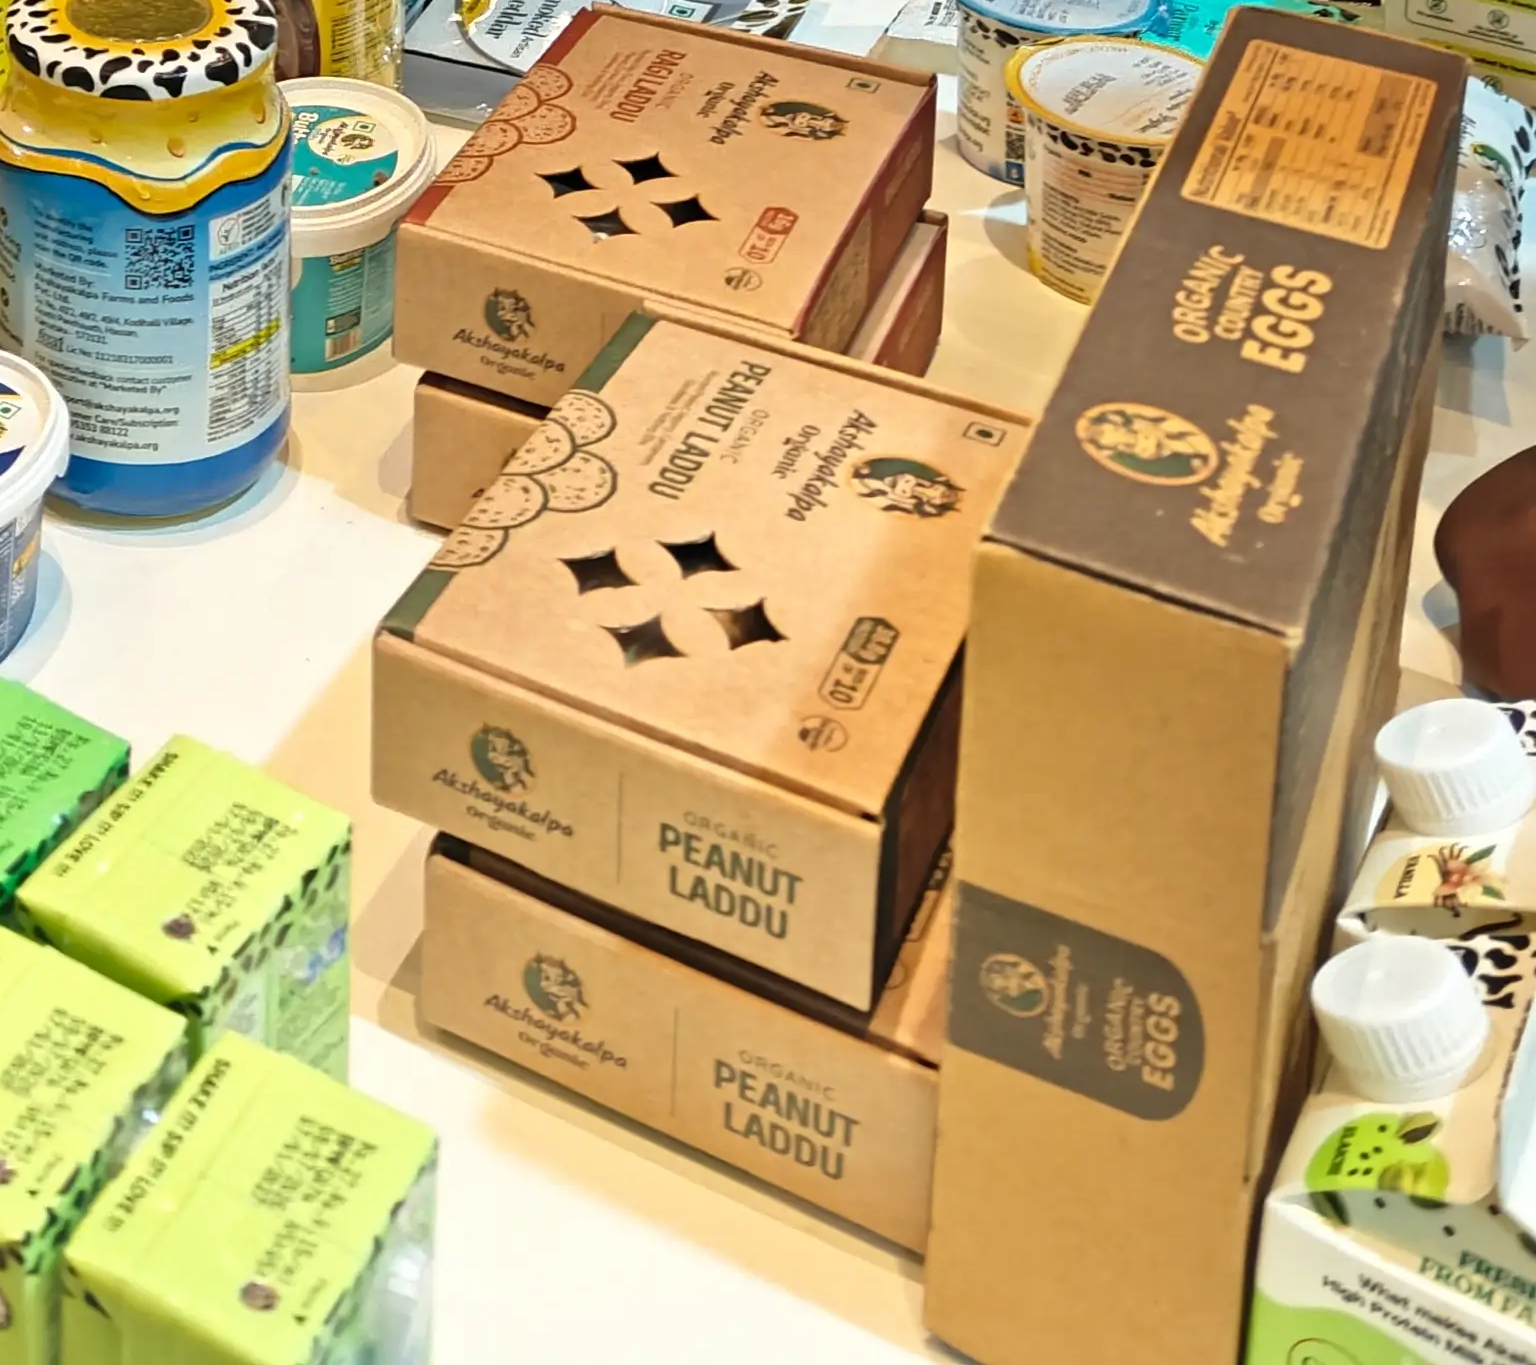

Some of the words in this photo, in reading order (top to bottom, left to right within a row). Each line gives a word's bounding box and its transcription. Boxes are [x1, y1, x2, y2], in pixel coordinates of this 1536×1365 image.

[610, 75, 662, 123] LADDU
[653, 50, 687, 89] RAGI
[709, 71, 779, 146] Akshayakalpa
[102, 292, 135, 304] Farms
[138, 295, 159, 304] and
[162, 293, 194, 303] Foods
[1172, 245, 1245, 343] ORGANIC
[1214, 265, 1263, 340] COUNTRY
[1240, 264, 1333, 374] EGGS
[452, 327, 566, 374] Akshayakalpa
[701, 360, 772, 432] PEANUT
[648, 430, 712, 500] LADDU
[771, 424, 821, 480] Organic
[784, 409, 878, 522] Akshayakalpa
[432, 769, 576, 838] Akshayakalpa
[683, 810, 780, 859] ORGANIC
[658, 822, 804, 905] PEANUT
[1394, 854, 1421, 898] VANILLA
[668, 865, 790, 940] LADDU
[484, 993, 629, 1069] Akshayakalpa
[1141, 992, 1182, 1092] EGGS
[713, 1058, 861, 1147] PEANUT
[738, 1048, 837, 1102] ORGANIC
[723, 1103, 845, 1181] LADDU
[1358, 1274, 1411, 1310] What
[1418, 1257, 1494, 1305] FROM
